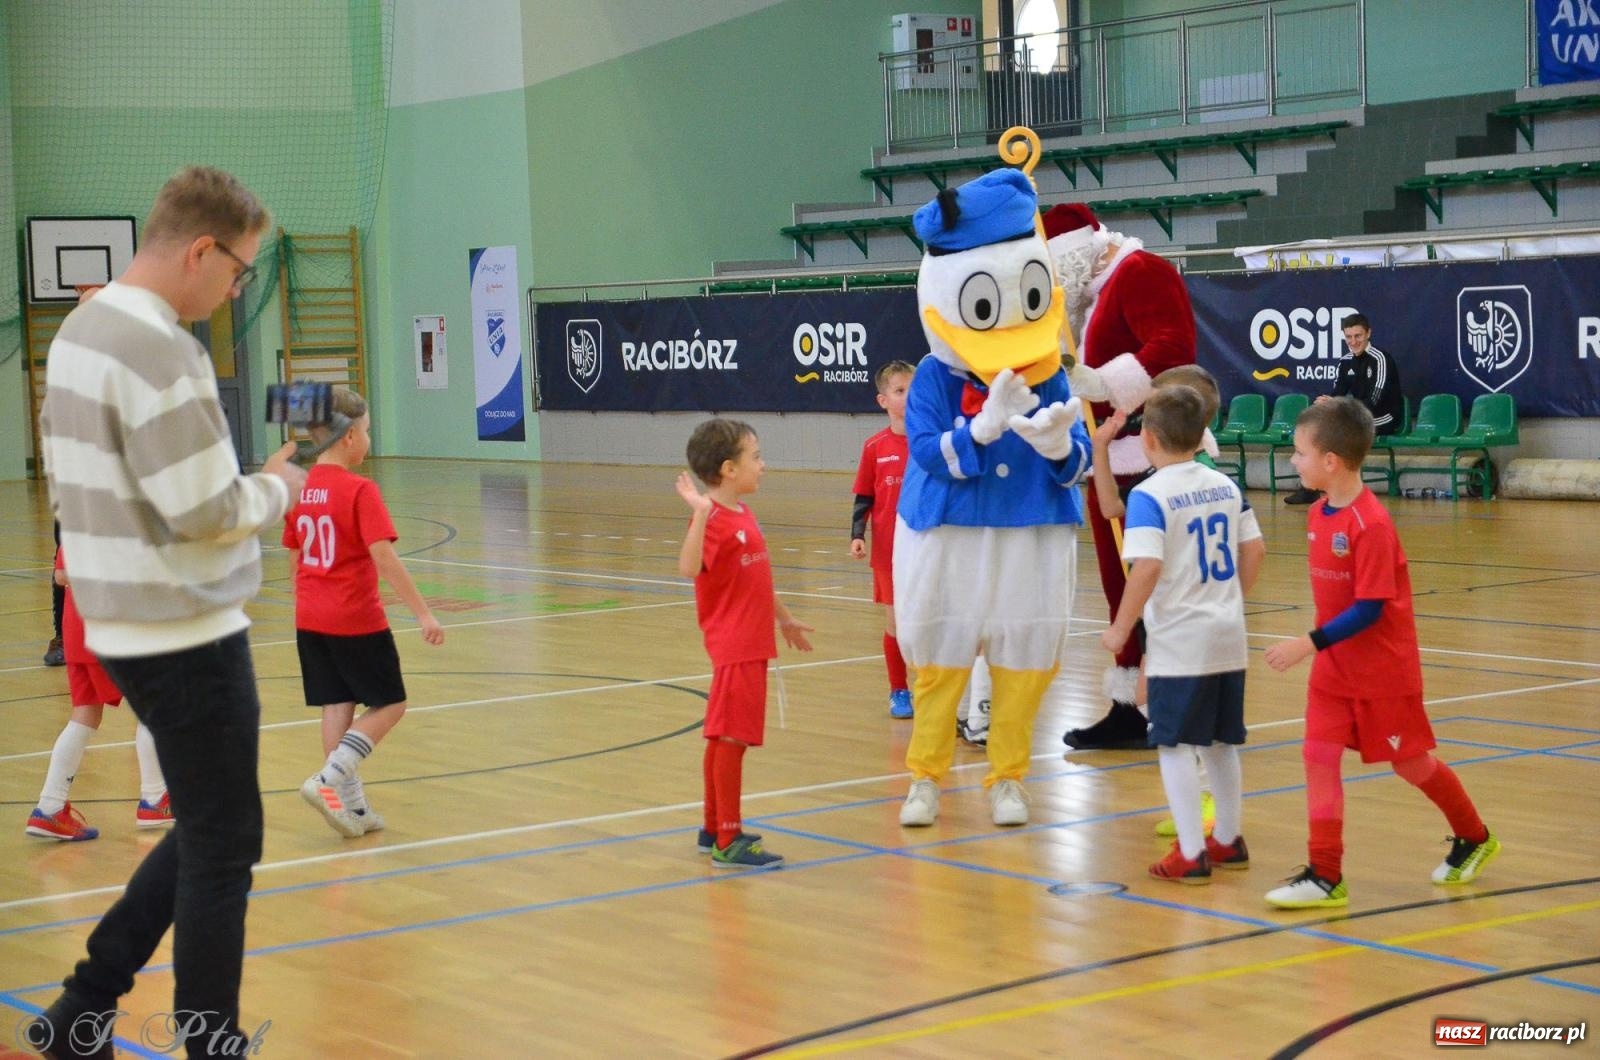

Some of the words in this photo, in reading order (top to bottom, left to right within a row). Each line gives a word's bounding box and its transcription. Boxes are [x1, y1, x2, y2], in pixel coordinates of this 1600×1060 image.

[621, 328, 738, 371] RACIBÓRZ
[793, 322, 868, 366] OSiR
[823, 367, 869, 383] RACIBÓRZ
[300, 488, 328, 504] LEON
[1166, 492, 1191, 511] UNIA
[297, 514, 335, 568] 20
[1186, 512, 1235, 584] 13
